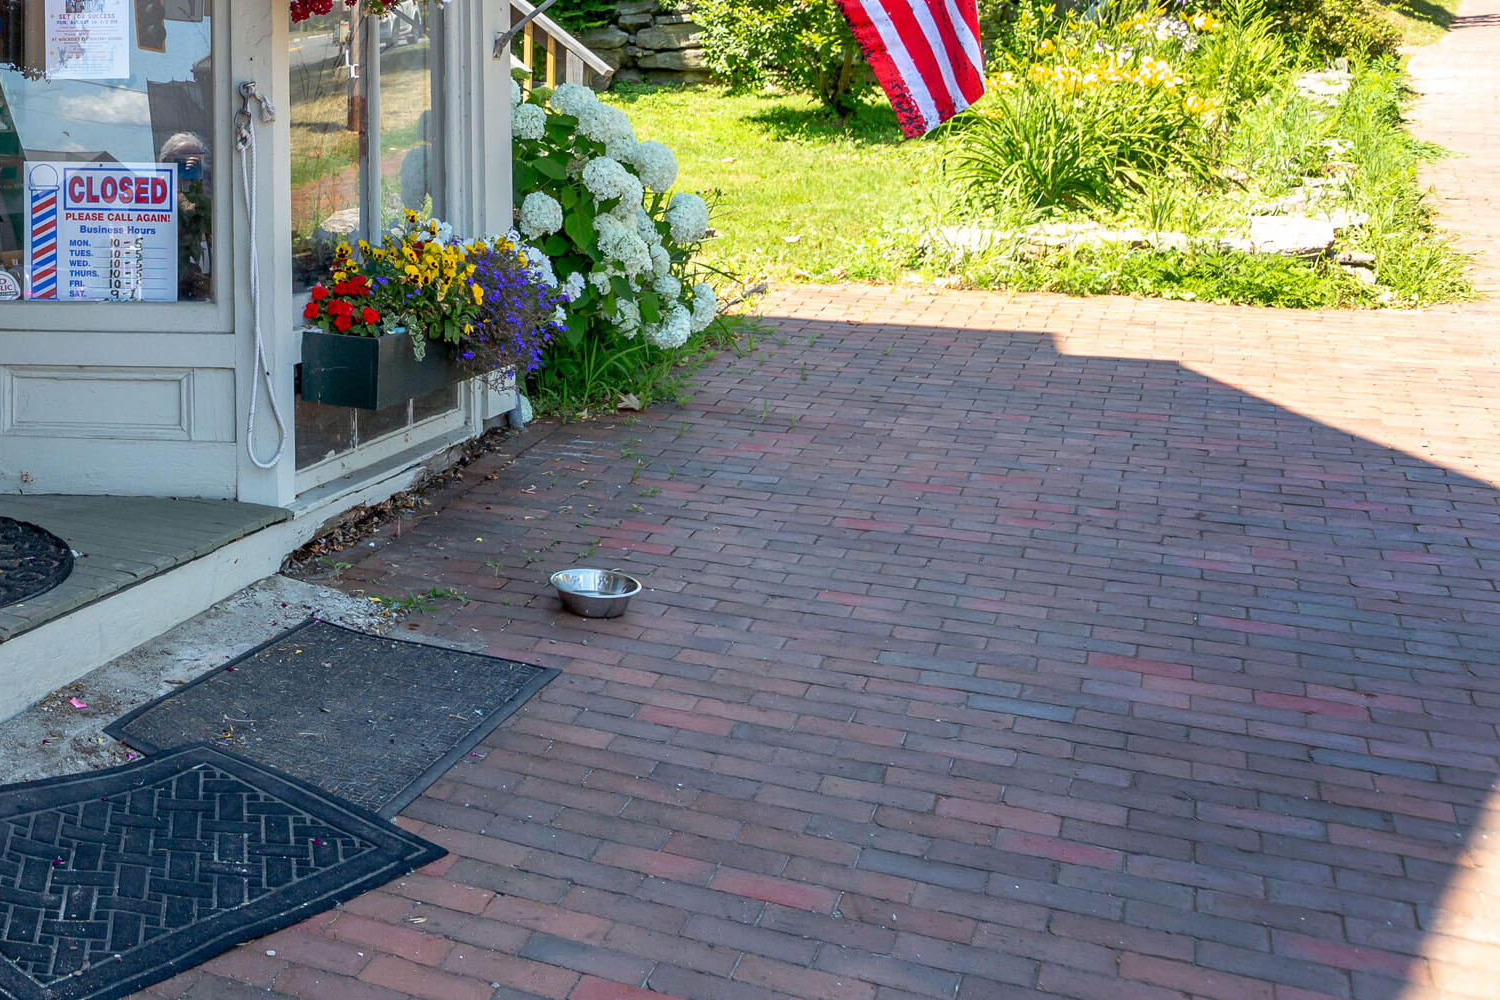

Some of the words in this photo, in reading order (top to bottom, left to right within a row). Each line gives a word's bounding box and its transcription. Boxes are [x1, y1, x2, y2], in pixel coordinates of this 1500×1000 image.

[68, 175, 168, 205] CLOSED
[65, 212, 104, 221] PLEASE
[107, 213, 133, 222] CALL
[136, 214, 171, 223] AGAIN!
[80, 225, 124, 234] Business
[127, 226, 156, 235] Hours
